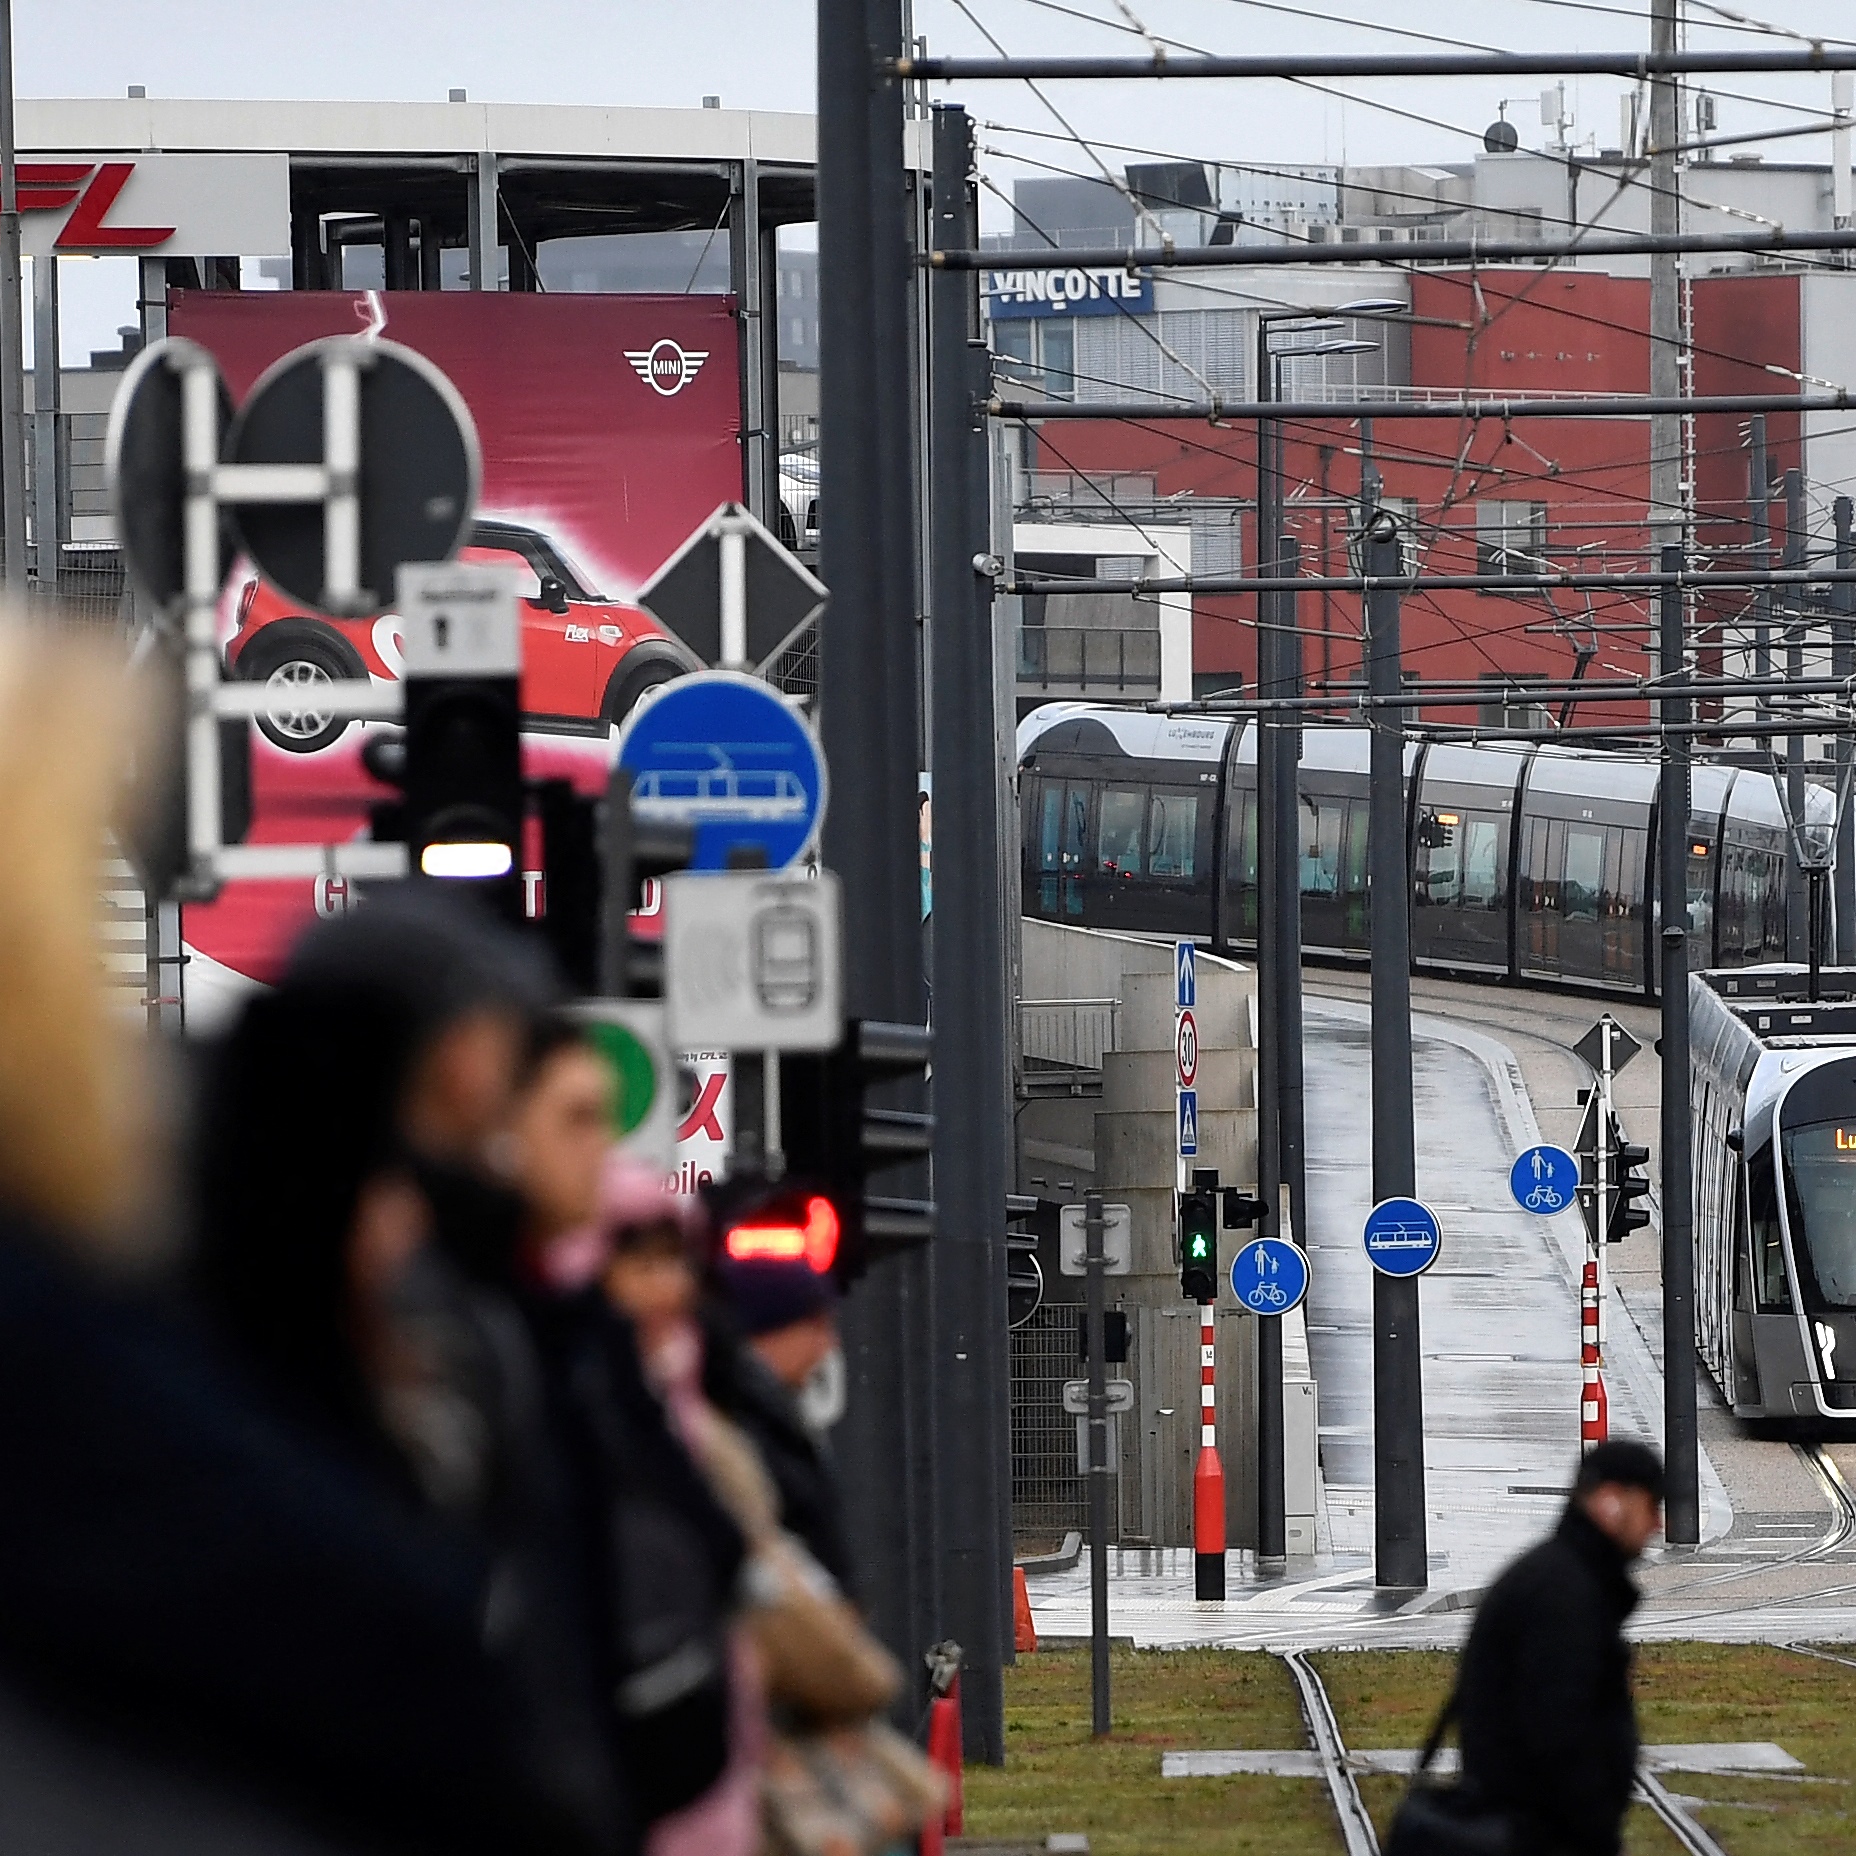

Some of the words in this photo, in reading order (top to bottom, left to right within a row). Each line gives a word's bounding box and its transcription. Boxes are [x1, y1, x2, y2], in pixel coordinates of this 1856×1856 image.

[993, 269, 1142, 310] VINÇOTTE
[653, 359, 681, 375] MINI
[1181, 1030, 1194, 1068] 30
